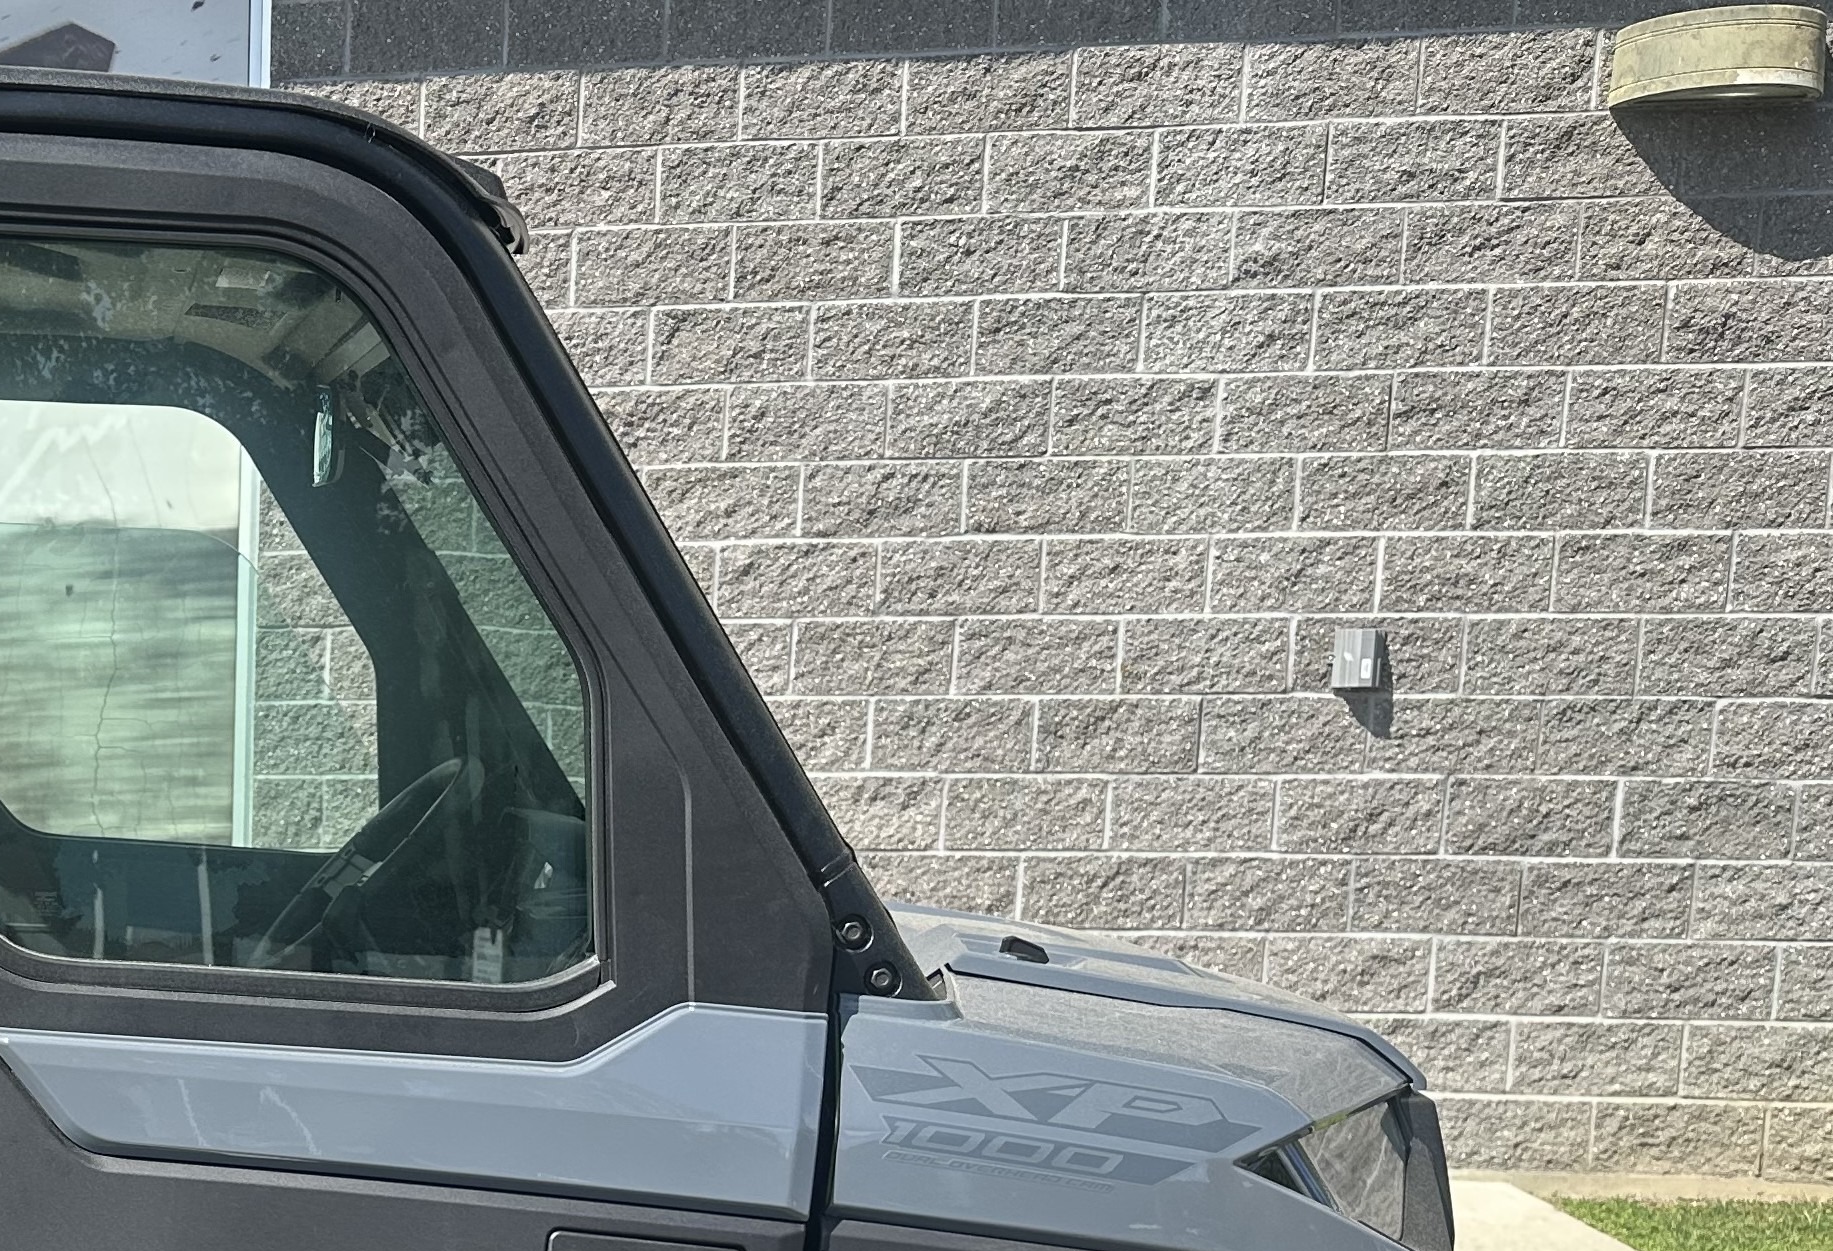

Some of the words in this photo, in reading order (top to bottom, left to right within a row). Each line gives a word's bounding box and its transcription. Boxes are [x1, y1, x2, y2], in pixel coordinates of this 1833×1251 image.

[874, 1053, 1230, 1128] XP
[880, 1116, 1125, 1176] 1000
[885, 1152, 943, 1166] DUAL
[948, 1160, 1061, 1184] OVERHEAD
[1064, 1177, 1115, 1193] CAM
